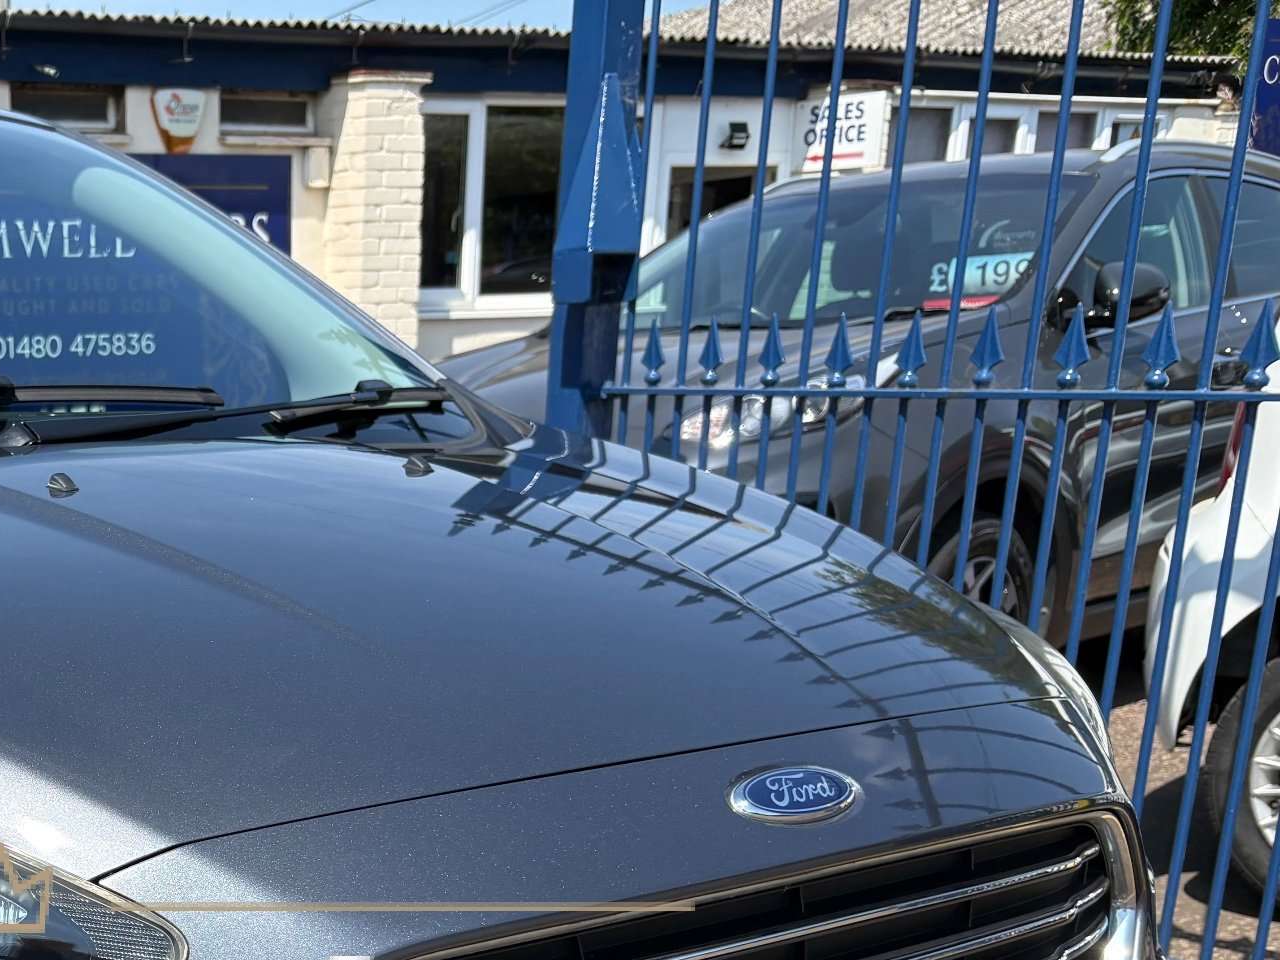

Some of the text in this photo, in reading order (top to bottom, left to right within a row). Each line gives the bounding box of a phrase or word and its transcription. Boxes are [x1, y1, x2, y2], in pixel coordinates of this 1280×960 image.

[809, 101, 866, 125] SAES
[804, 124, 867, 147] OFICE
[65, 273, 118, 292] USED
[69, 332, 157, 358] 475836
[765, 772, 836, 808] Ford
